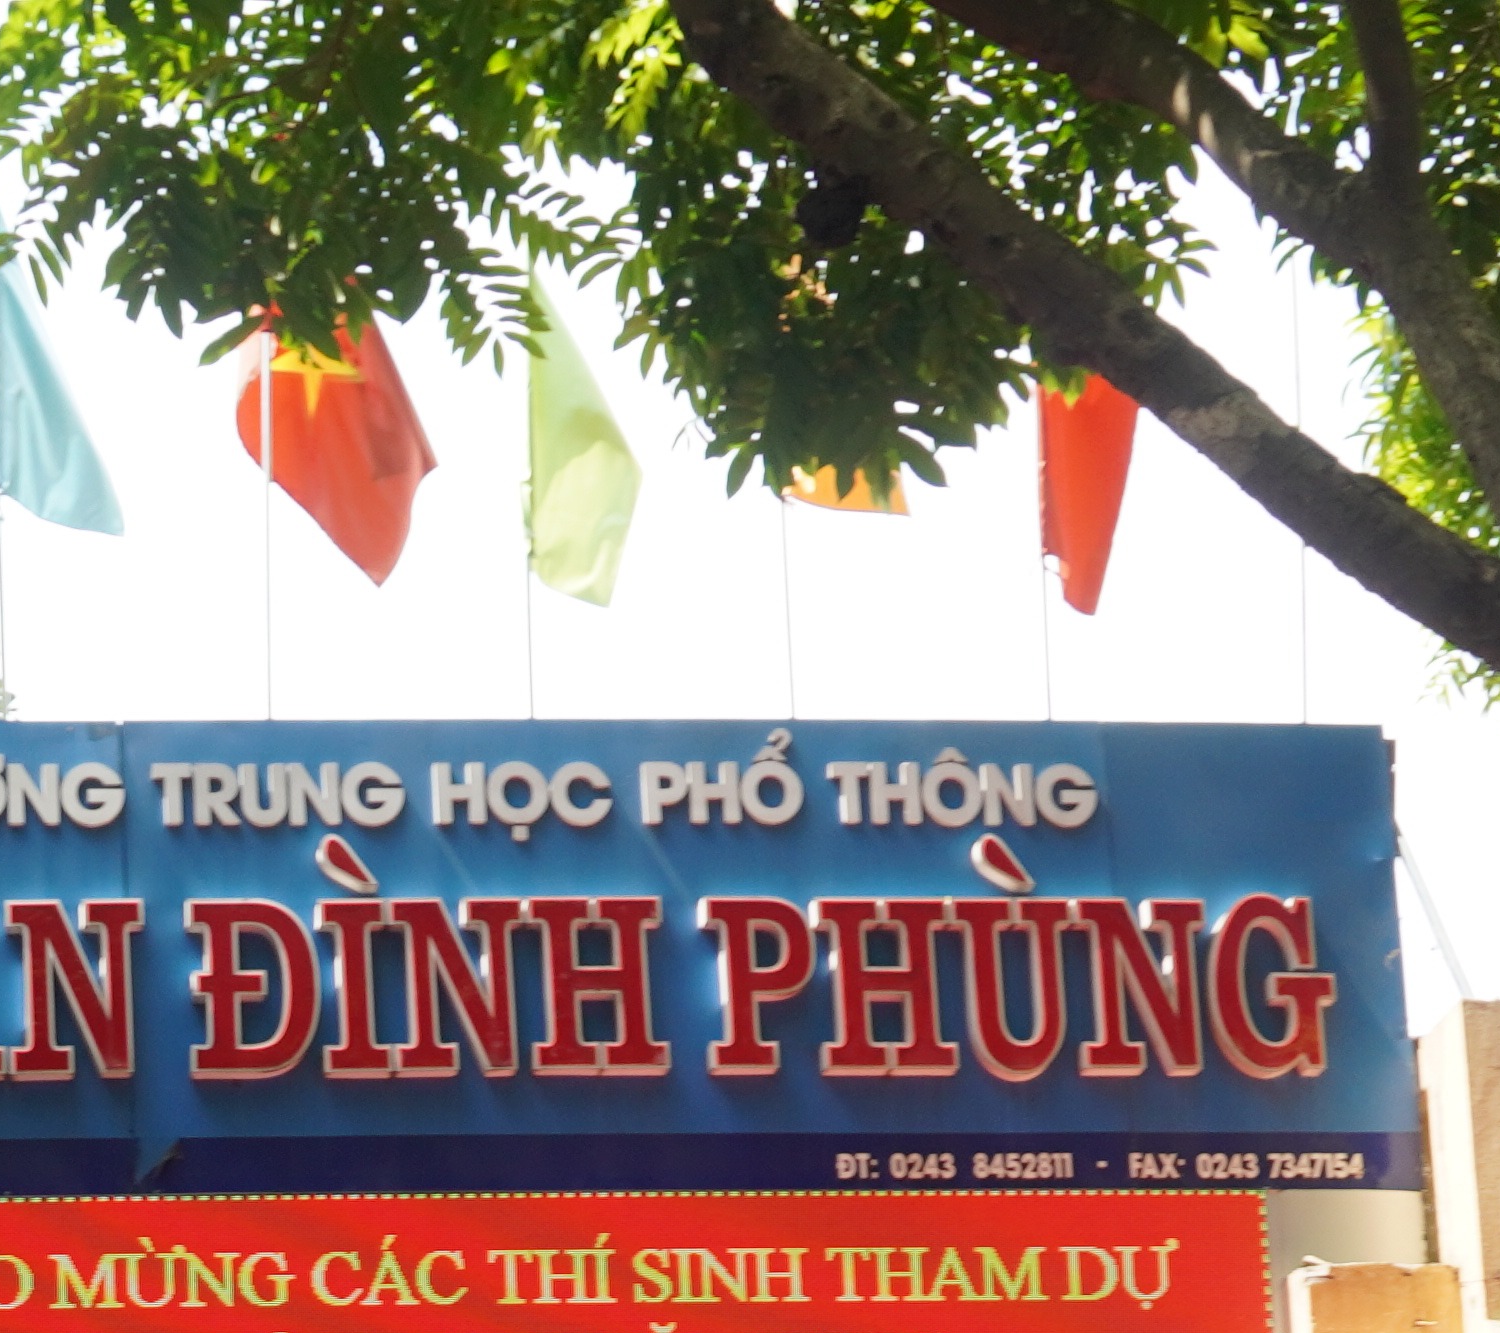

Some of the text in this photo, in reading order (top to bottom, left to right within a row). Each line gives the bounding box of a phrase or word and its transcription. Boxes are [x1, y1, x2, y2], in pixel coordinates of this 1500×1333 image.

[150, 760, 406, 828] TRUNG
[430, 760, 613, 842] HỌC
[639, 728, 805, 828] PHỔ
[826, 747, 1099, 828] THÔNG
[184, 834, 672, 1083] ĐÌNH
[697, 833, 1338, 1083] PHÙNG
[836, 1152, 879, 1179] ĐT:
[888, 1152, 957, 1180] 0243
[972, 1152, 1075, 1180] 8452811
[1195, 1152, 1260, 1180] 0243
[1266, 1152, 1366, 1180] 7347154
[46, 1238, 291, 1309] MỪNG
[309, 1234, 467, 1308] CÁC
[486, 1233, 619, 1304] THÍ
[632, 1246, 808, 1304] SINH
[825, 1245, 1048, 1303] THAM
[1058, 1237, 1181, 1311] DỰ
